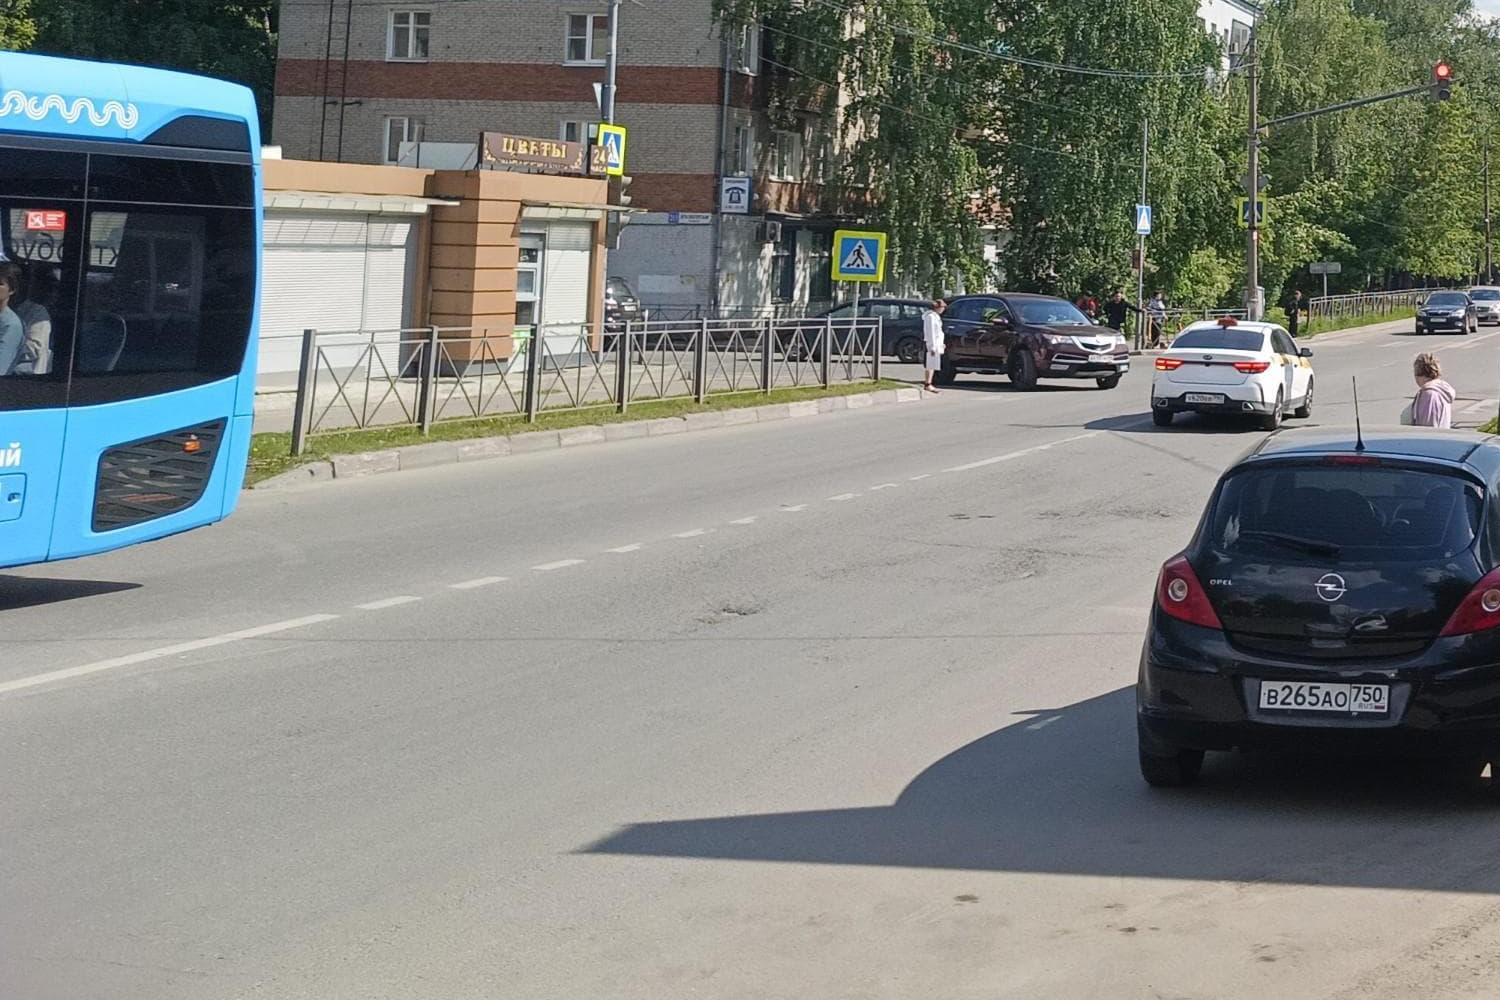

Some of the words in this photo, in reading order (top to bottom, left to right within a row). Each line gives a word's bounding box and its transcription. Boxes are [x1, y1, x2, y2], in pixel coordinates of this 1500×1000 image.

[502, 137, 568, 158] ЦВЕТЫ
[594, 149, 606, 164] 24
[1266, 685, 1348, 708] В265АО
[1352, 687, 1383, 702] 750
